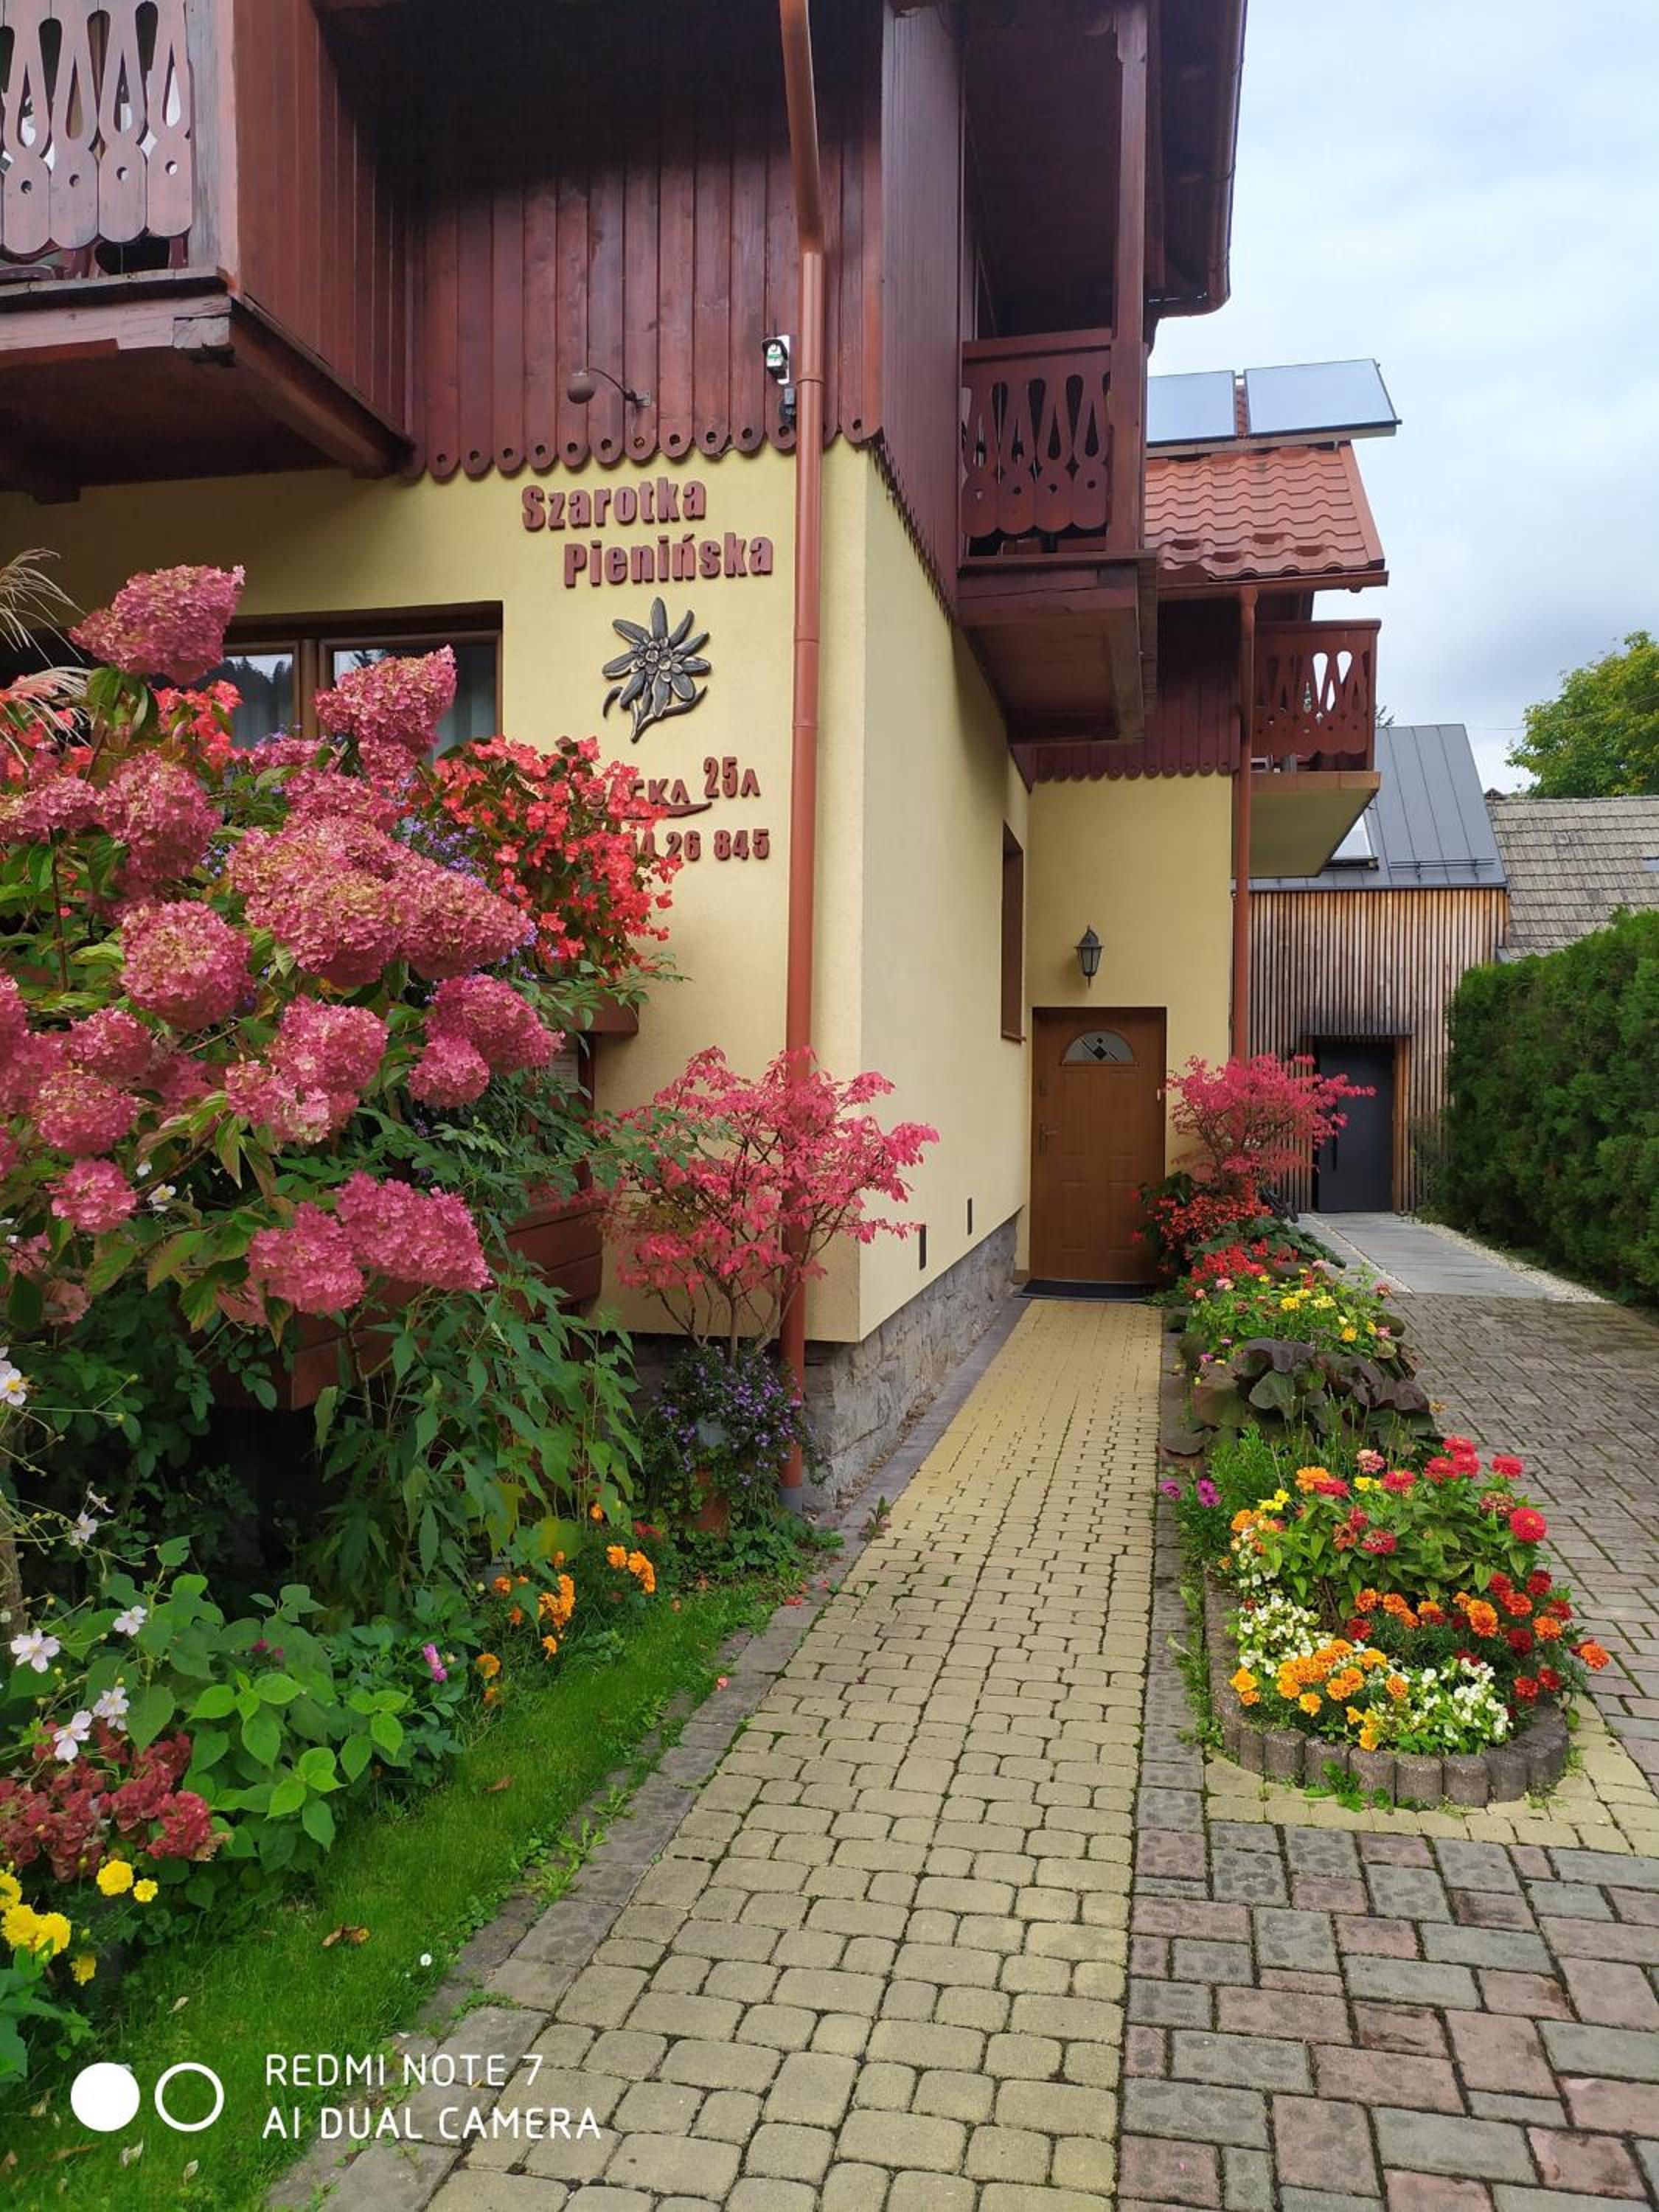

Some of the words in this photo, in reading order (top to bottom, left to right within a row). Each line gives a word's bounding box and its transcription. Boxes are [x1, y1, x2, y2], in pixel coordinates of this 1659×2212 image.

[521, 476, 706, 532] Szarotka
[564, 532, 773, 588] Pienińska
[666, 830, 700, 861] 26
[713, 828, 771, 861] 845
